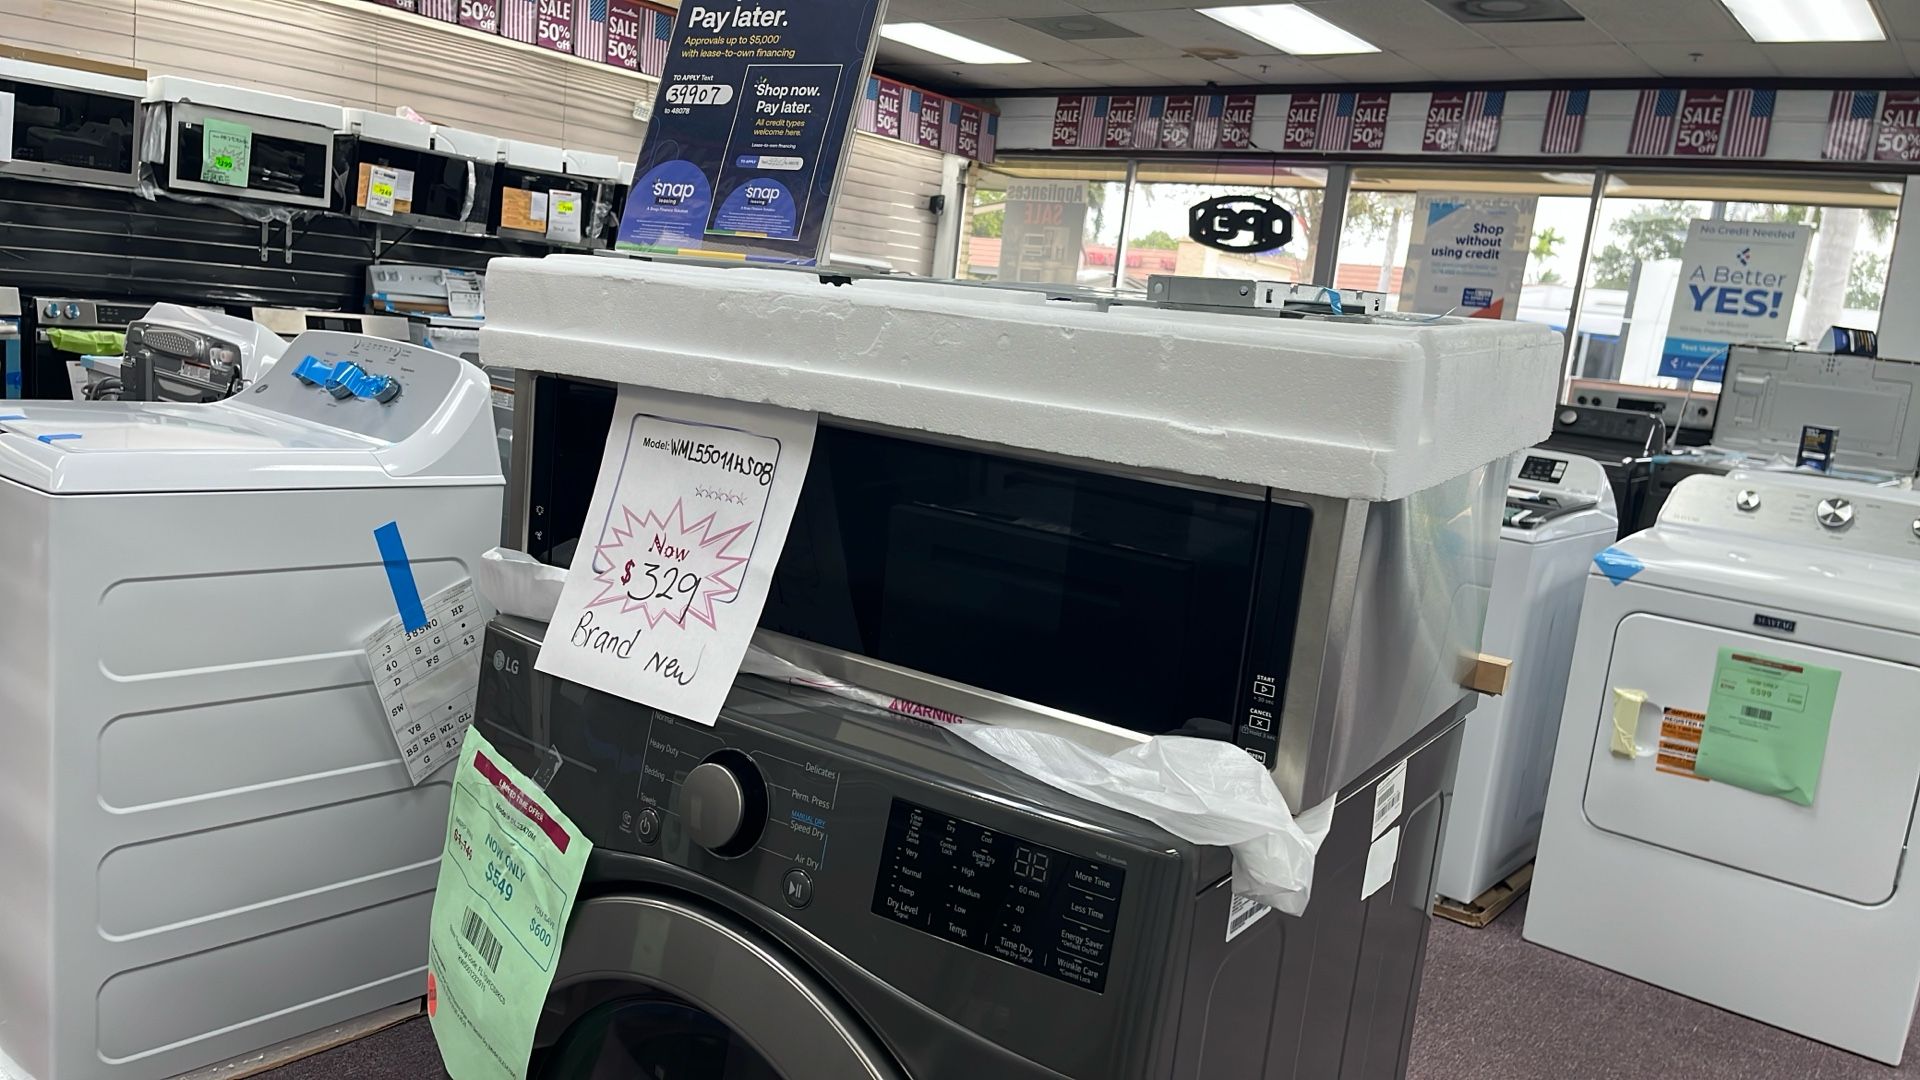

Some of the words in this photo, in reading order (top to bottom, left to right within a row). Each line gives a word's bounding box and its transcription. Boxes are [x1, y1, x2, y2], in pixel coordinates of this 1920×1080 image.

[461, 0, 495, 20] 50%
[540, 0, 571, 20] SALE
[480, 19, 496, 31] off
[688, 7, 732, 33] Pay
[732, 5, 788, 28] later.
[539, 21, 570, 41] 50%
[609, 16, 638, 40] SALE
[556, 40, 570, 50] off
[684, 36, 725, 45] Approvals
[726, 37, 737, 45] up
[738, 36, 748, 45] to
[608, 39, 637, 59] 50%
[681, 48, 699, 58] with
[699, 49, 755, 58] lease-to-own
[756, 48, 795, 59] financing
[624, 58, 638, 67] off
[668, 85, 721, 105] 39907
[756, 83, 789, 99] Shop
[790, 84, 821, 97] now.
[755, 100, 780, 116] Pay
[780, 101, 812, 114] later.
[879, 95, 899, 113] SALE
[877, 114, 898, 130] 50%
[921, 107, 940, 125] SALE
[1056, 110, 1079, 123] SALE
[1109, 110, 1133, 123] SALE
[1165, 110, 1191, 123] SALE
[1224, 109, 1251, 124] SALE
[1288, 108, 1318, 123] SALE
[1355, 108, 1386, 123] SALE
[1428, 108, 1461, 123] SALE
[1682, 106, 1722, 124] SALE
[755, 119, 765, 127] All
[765, 119, 785, 127] credit
[785, 119, 805, 128] types
[960, 119, 978, 136] SALE
[753, 128, 784, 136] welcome
[920, 126, 938, 141] 50%
[1053, 127, 1077, 141] 50%
[1107, 127, 1131, 142] 50%
[1222, 127, 1249, 142] 50%
[1286, 127, 1315, 142] 50%
[1352, 127, 1384, 143] 50%
[1425, 128, 1458, 144] 50%
[1678, 129, 1719, 147] 50%
[1300, 138, 1313, 148] off
[1368, 139, 1382, 149] off
[1698, 143, 1716, 154] off
[653, 181, 695, 203] snap
[745, 185, 780, 204] snap
[1472, 222, 1504, 237] Shop
[1700, 225, 1716, 236] No
[1718, 225, 1749, 237] Credit
[1752, 228, 1796, 240] Needed
[1455, 235, 1502, 248] without
[1431, 246, 1463, 260] using
[1465, 247, 1500, 260] credit
[1690, 265, 1706, 281] A
[1714, 266, 1786, 287] Better
[1688, 284, 1784, 319] YES!
[643, 437, 670, 451] Model:
[648, 533, 690, 563] Now
[621, 559, 702, 625] $329
[451, 604, 465, 617] HP
[433, 636, 441, 645] G
[463, 634, 476, 647] 43
[414, 646, 422, 655] S
[571, 611, 641, 659] Brand
[643, 643, 706, 686] New
[386, 660, 398, 673] 40
[426, 655, 440, 668] FS
[505, 655, 520, 674] LG
[394, 677, 402, 687] D
[1256, 674, 1275, 683] START
[391, 703, 404, 717] SW
[900, 699, 964, 724] WARNING
[1249, 707, 1272, 718] CANCEL
[439, 722, 454, 735] WL
[458, 711, 471, 723] GL
[655, 711, 674, 725] Normal
[408, 723, 422, 736] V8
[406, 744, 419, 758] BS
[423, 732, 437, 746] RS
[445, 737, 458, 749] 41
[650, 738, 666, 752] Heavy
[665, 744, 679, 758] Duty
[423, 755, 431, 764] G
[644, 764, 665, 782] Bedding
[805, 762, 836, 780] Delicates
[791, 788, 810, 802] Perm.
[812, 796, 830, 810] Press
[790, 821, 811, 835] Speed
[811, 828, 825, 840] Dry
[485, 833, 503, 861] NOW
[505, 854, 526, 883] ONLY
[905, 848, 918, 859] Very
[794, 854, 805, 864] Air
[807, 858, 820, 871] Dry
[902, 866, 922, 879] Normal
[961, 866, 975, 878] High
[1075, 870, 1093, 883] More
[1094, 877, 1111, 888] Time
[485, 861, 513, 901] $549
[898, 885, 915, 897] Damp
[1018, 885, 1028, 895] 60
[1028, 889, 1040, 899] min
[887, 897, 900, 909] Dry
[900, 901, 919, 915] Level
[954, 904, 967, 915] Low
[1015, 905, 1025, 914] 40
[1071, 902, 1086, 914] Less
[1087, 907, 1104, 919] Time
[529, 917, 551, 947] $600
[949, 922, 968, 937] Temp.
[1012, 924, 1021, 933] 20
[1000, 937, 1018, 950] Time
[1019, 943, 1034, 957] Dry
[1061, 929, 1083, 945] Energy
[1085, 937, 1104, 950] Saver
[1057, 957, 1082, 972] Wrinkle
[1083, 967, 1099, 979] Care
